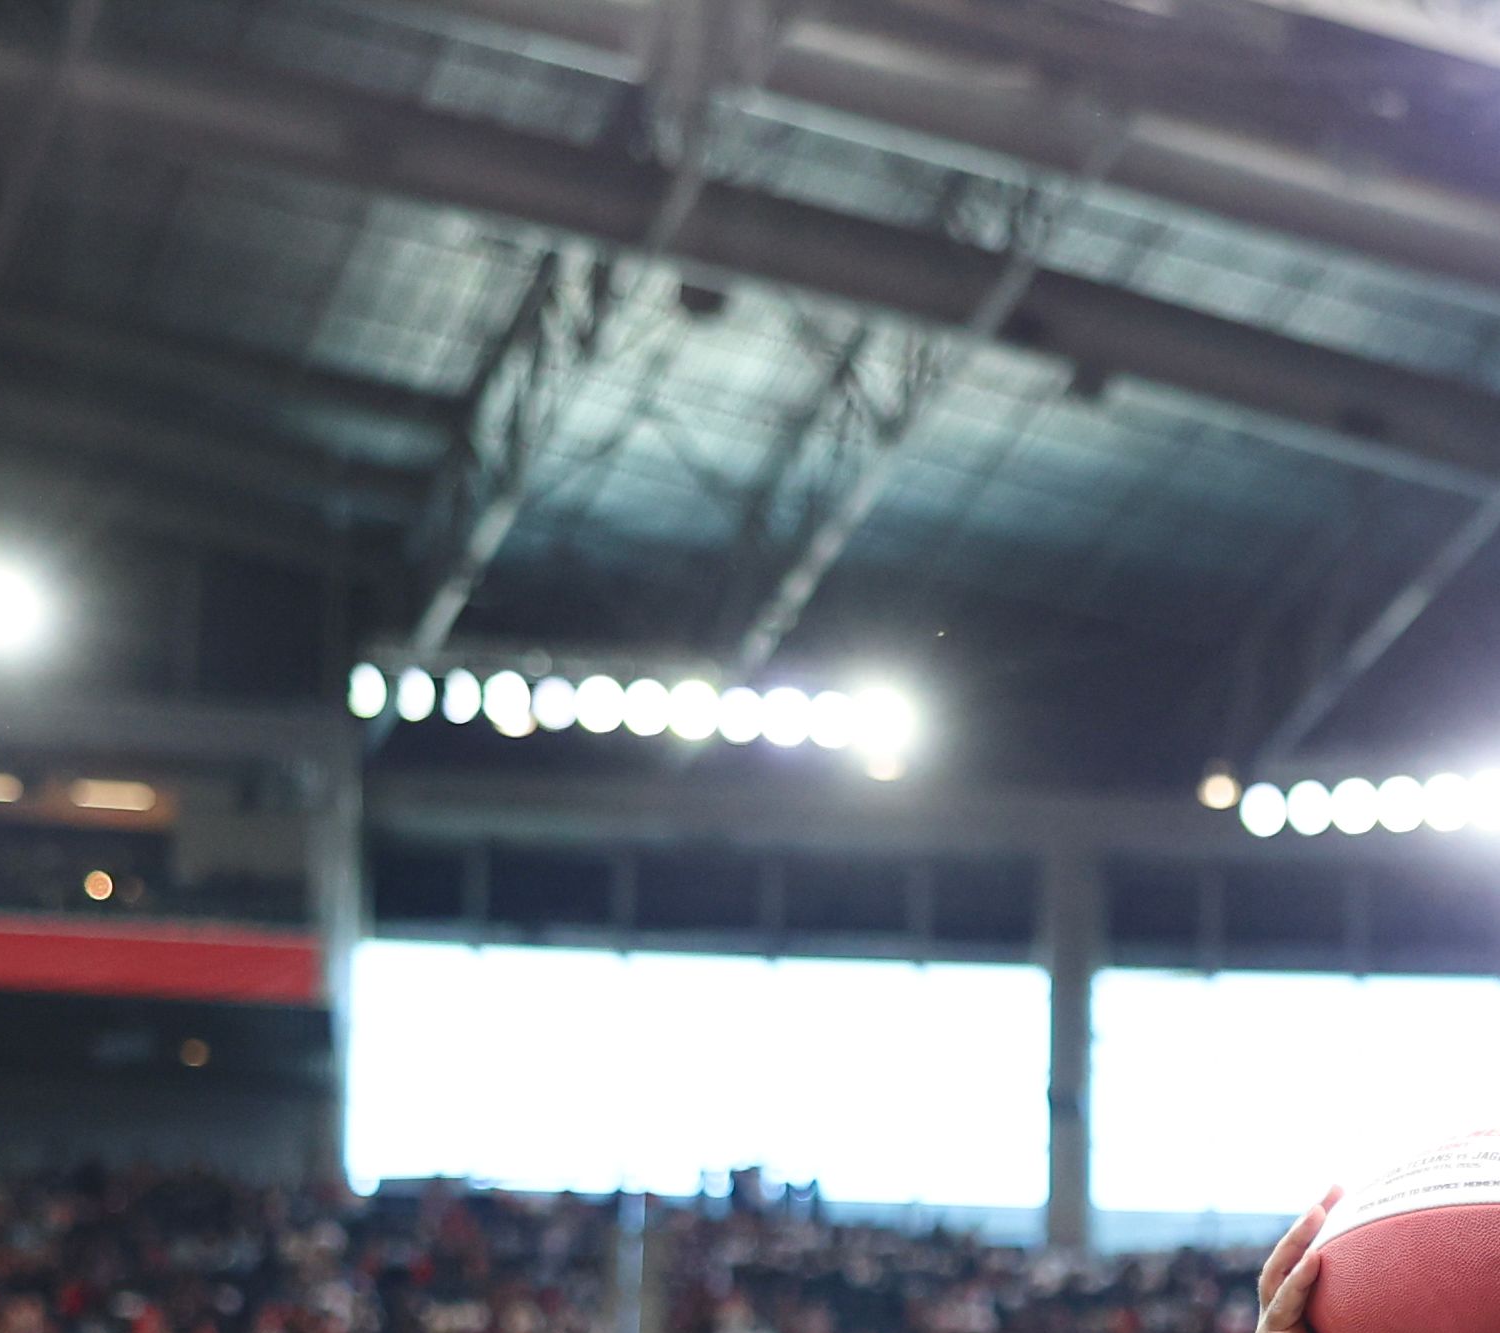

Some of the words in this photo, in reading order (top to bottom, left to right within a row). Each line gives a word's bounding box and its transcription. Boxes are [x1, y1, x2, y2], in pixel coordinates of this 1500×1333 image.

[1377, 1190, 1407, 1206] SALUTE
[1409, 1187, 1421, 1197] TO
[1422, 1181, 1460, 1194] SERVICE
